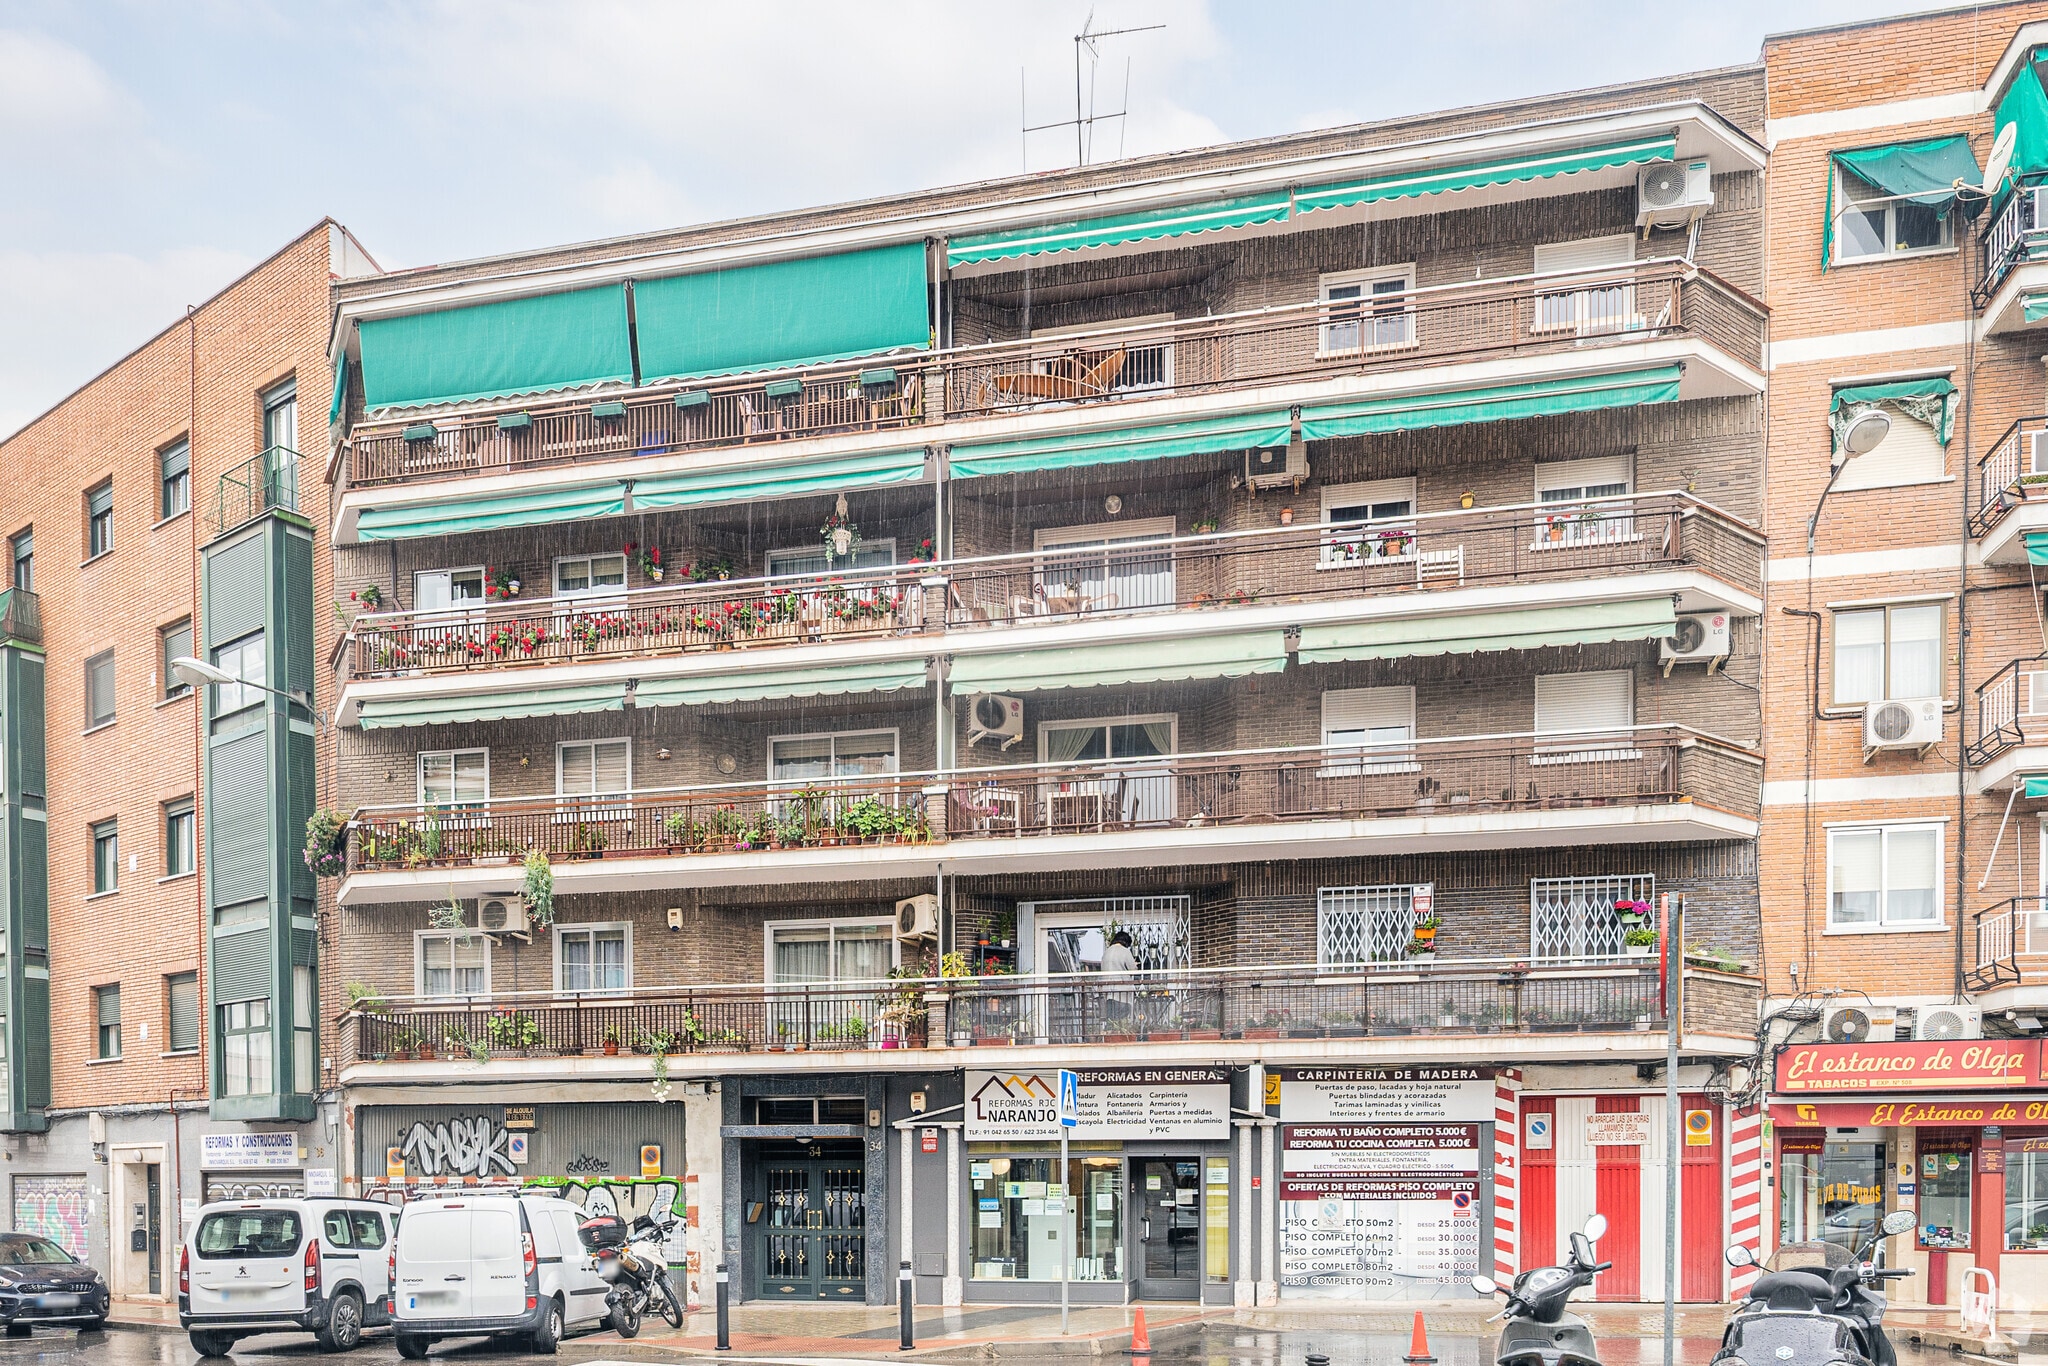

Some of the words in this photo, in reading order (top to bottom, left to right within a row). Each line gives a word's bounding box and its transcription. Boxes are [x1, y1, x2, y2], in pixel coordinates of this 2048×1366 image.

[1788, 1050, 1818, 1079] El
[1820, 1052, 1916, 1072] estanco
[1921, 1048, 1952, 1071] de
[1962, 1047, 2024, 1076] Olga
[1077, 1072, 1141, 1082] REFORMAS
[1145, 1071, 1161, 1081] EN
[1165, 1071, 1224, 1081] GENERAL
[1297, 1068, 1387, 1080] CARPINTERÍA
[1394, 1070, 1412, 1079] DE
[1419, 1070, 1478, 1079] MADERA
[1808, 1079, 1867, 1088] TABACOS
[988, 1099, 1033, 1107] REFORMAS
[988, 1110, 1056, 1122] NARANJO
[1587, 1115, 1593, 1123] NO
[1595, 1115, 1615, 1123] APARCAR
[1617, 1115, 1625, 1123] LAS
[1627, 1115, 1632, 1123] 24
[1634, 1115, 1649, 1123] HORAS
[1869, 1104, 1896, 1125] El
[1899, 1104, 1984, 1126] Estanco
[1990, 1103, 2017, 1120] de
[1294, 1128, 1338, 1136] REFORMA
[1339, 1128, 1351, 1136] TU
[1353, 1126, 1381, 1136] BAÑO
[1383, 1127, 1434, 1136] COMPLETO
[1599, 1124, 1624, 1132] LLAMAMOS
[1626, 1124, 1638, 1132] GRUA
[206, 1136, 233, 1148] REFORMAS
[242, 1134, 292, 1148] CONSTRUCCIONES
[1615, 1133, 1621, 1141] SE
[1623, 1133, 1647, 1141] LAMENTEN
[869, 1142, 881, 1151] 34
[1290, 1140, 1333, 1148] REFORMA
[809, 1147, 821, 1156] 34
[1837, 1183, 1848, 1200] DE
[1851, 1185, 1881, 1205] PUROS
[1366, 1277, 1394, 1285] 90m2
